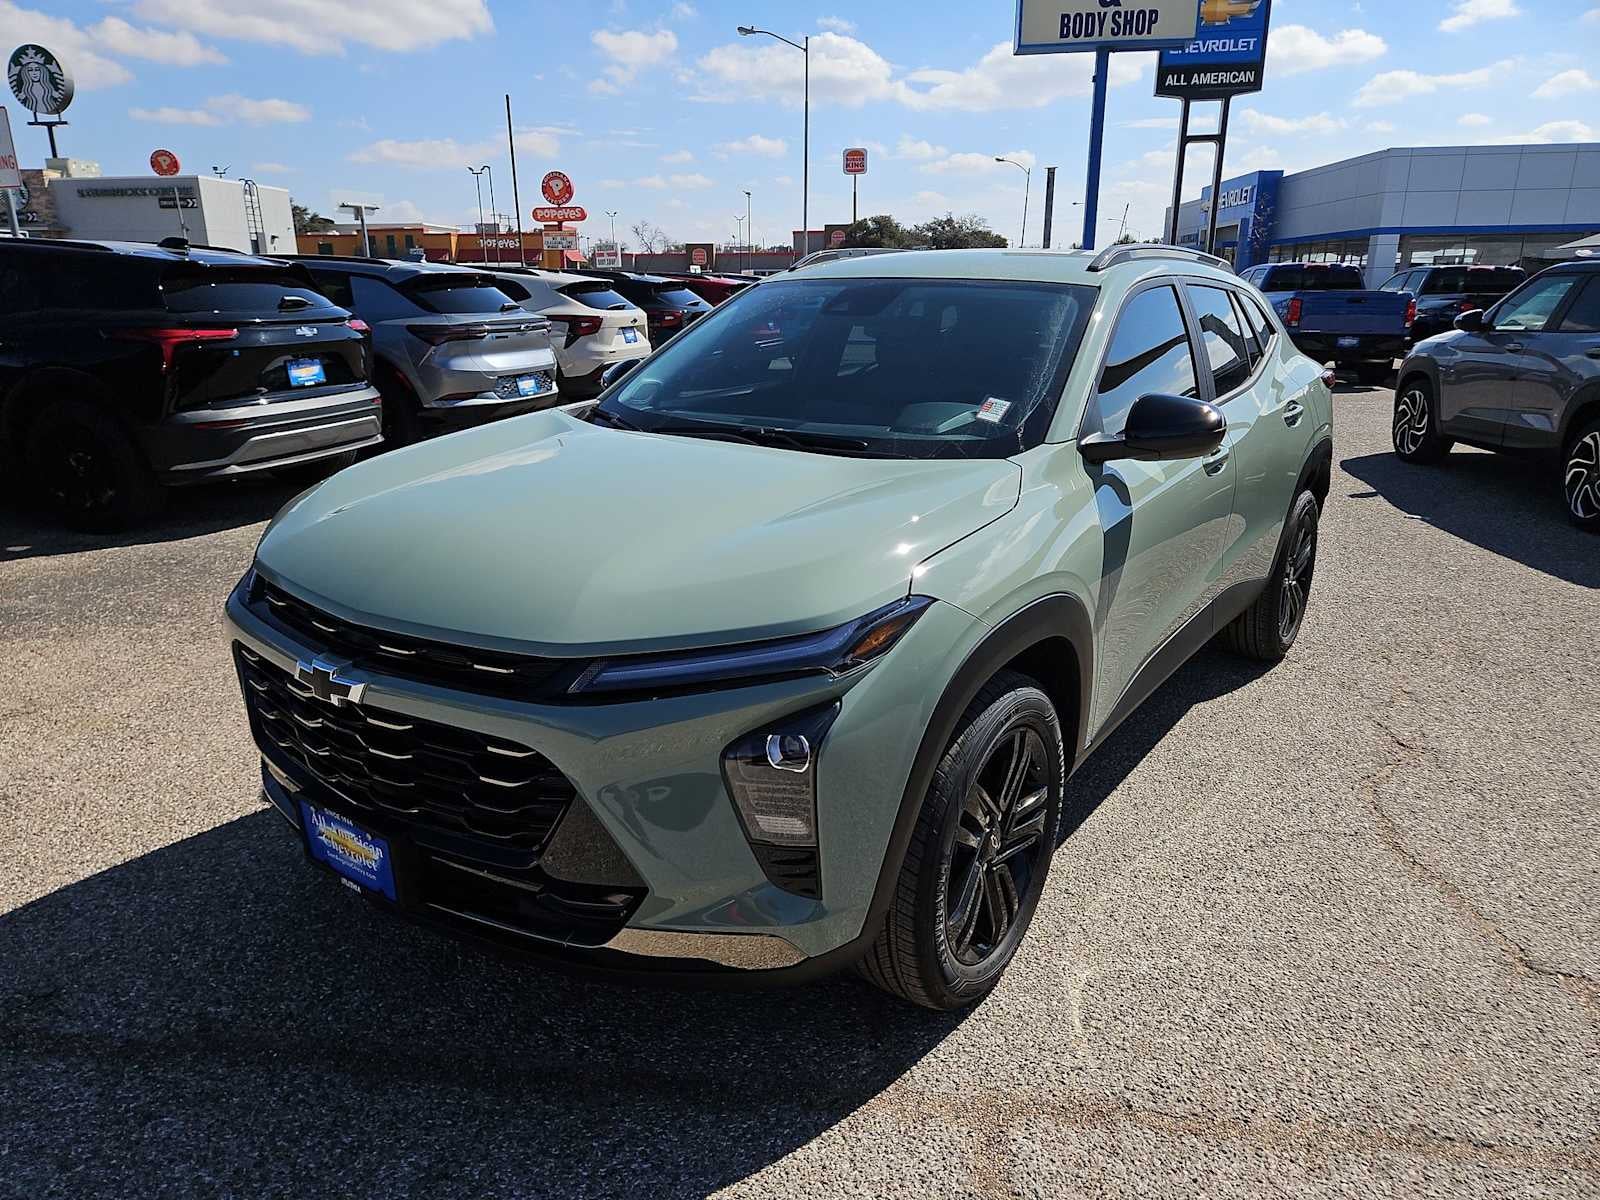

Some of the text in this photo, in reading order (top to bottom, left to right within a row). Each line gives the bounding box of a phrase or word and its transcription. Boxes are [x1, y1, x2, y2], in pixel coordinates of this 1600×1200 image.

[1060, 9, 1159, 39] BODY SHOP
[1169, 38, 1258, 54] EVROLET
[1165, 71, 1255, 87] ALL AMERICAN
[1219, 185, 1252, 209] EVROLET
